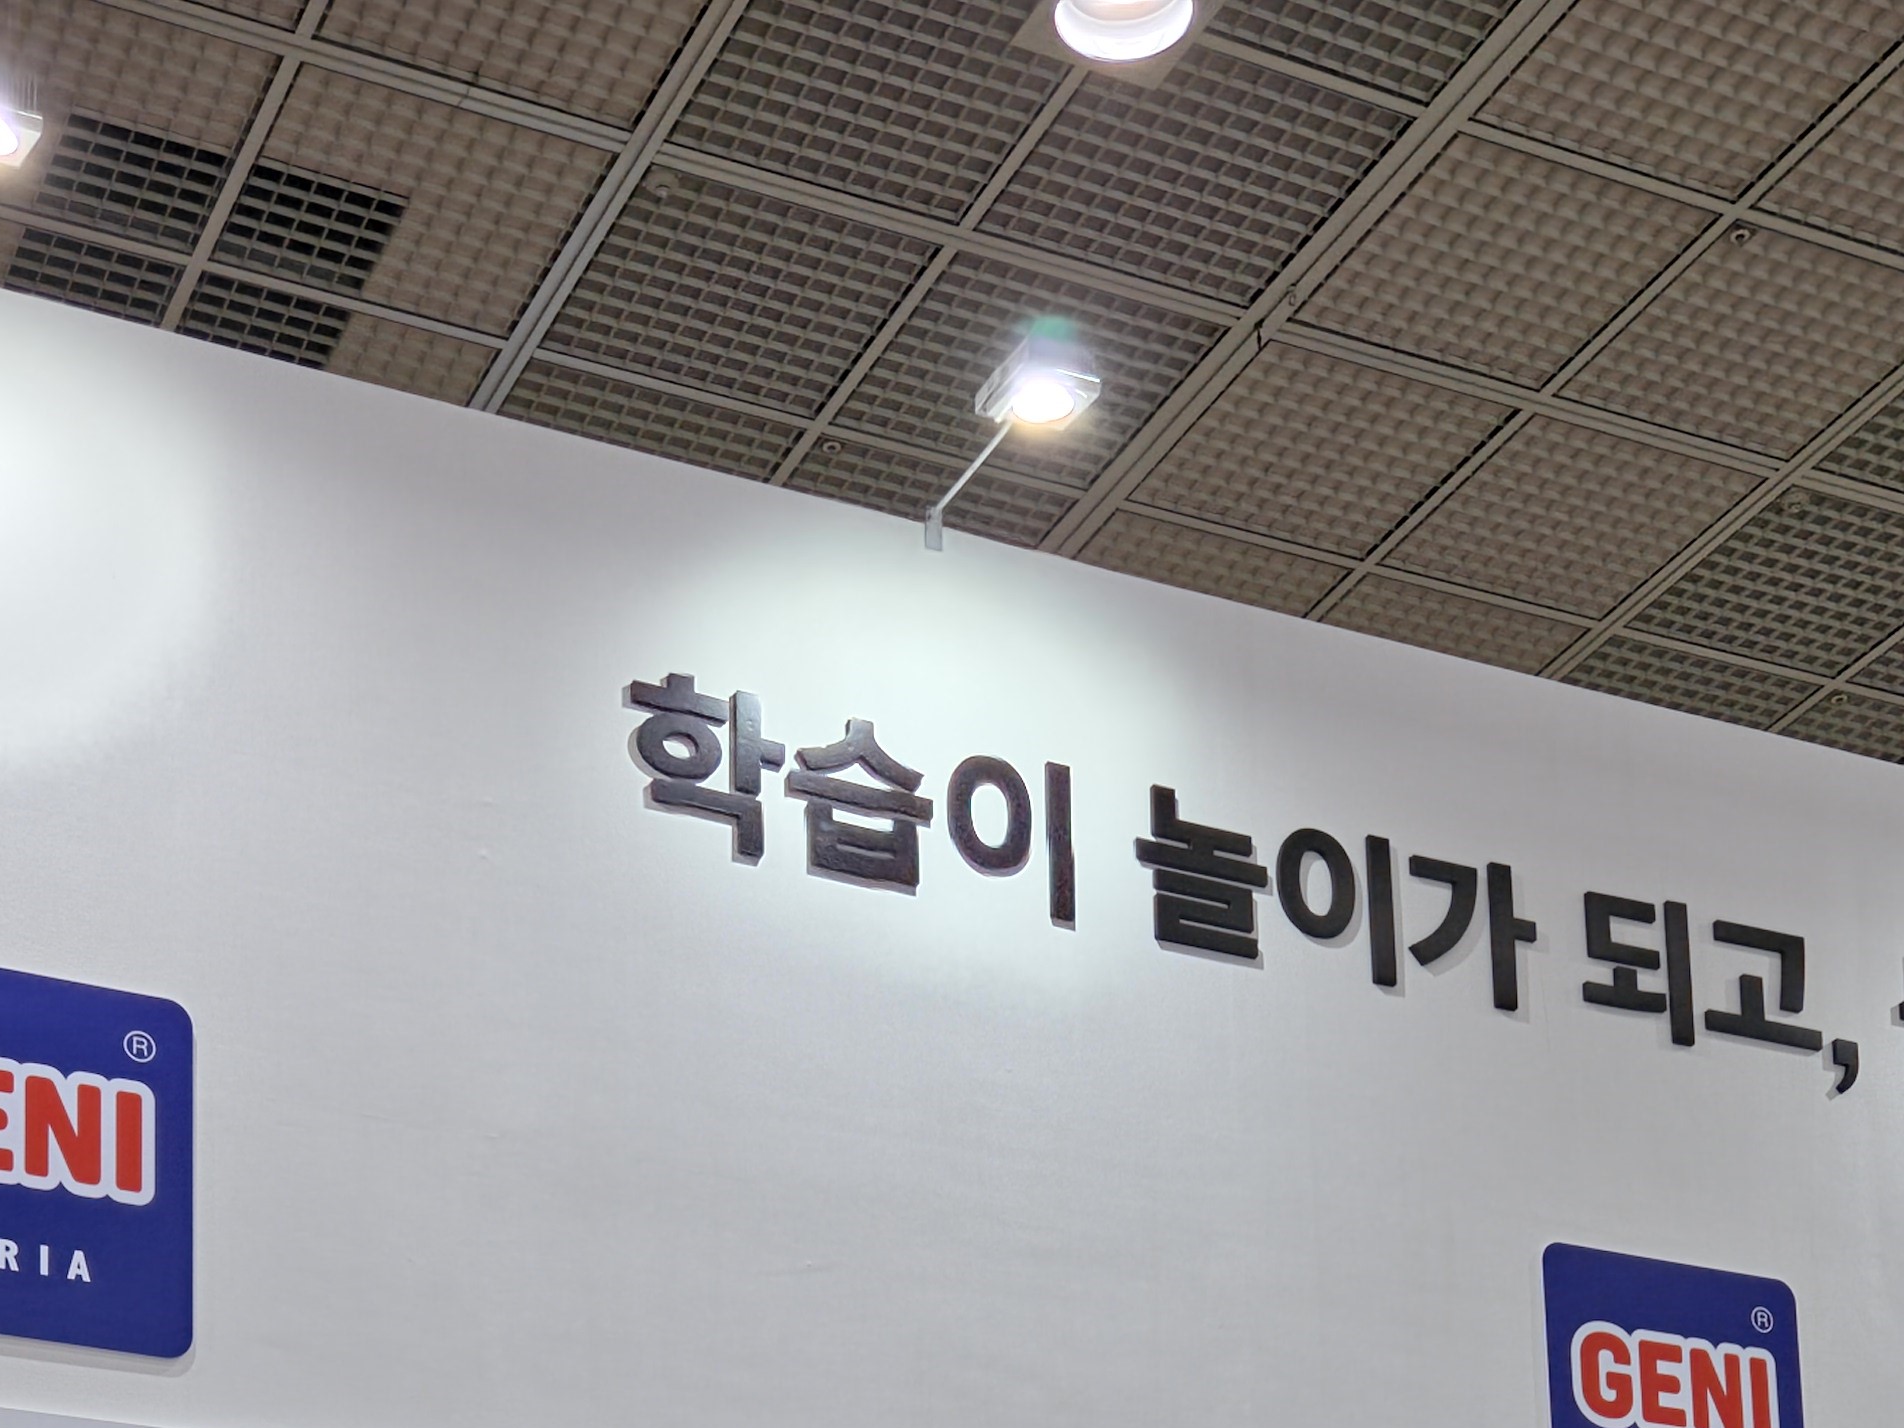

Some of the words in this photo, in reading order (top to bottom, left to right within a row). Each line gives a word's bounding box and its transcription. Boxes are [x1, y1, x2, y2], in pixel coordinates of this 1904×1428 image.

[626, 672, 1076, 932] 학습이
[1135, 785, 1537, 1013] 놀이가
[1581, 890, 1861, 1096] 되고,
